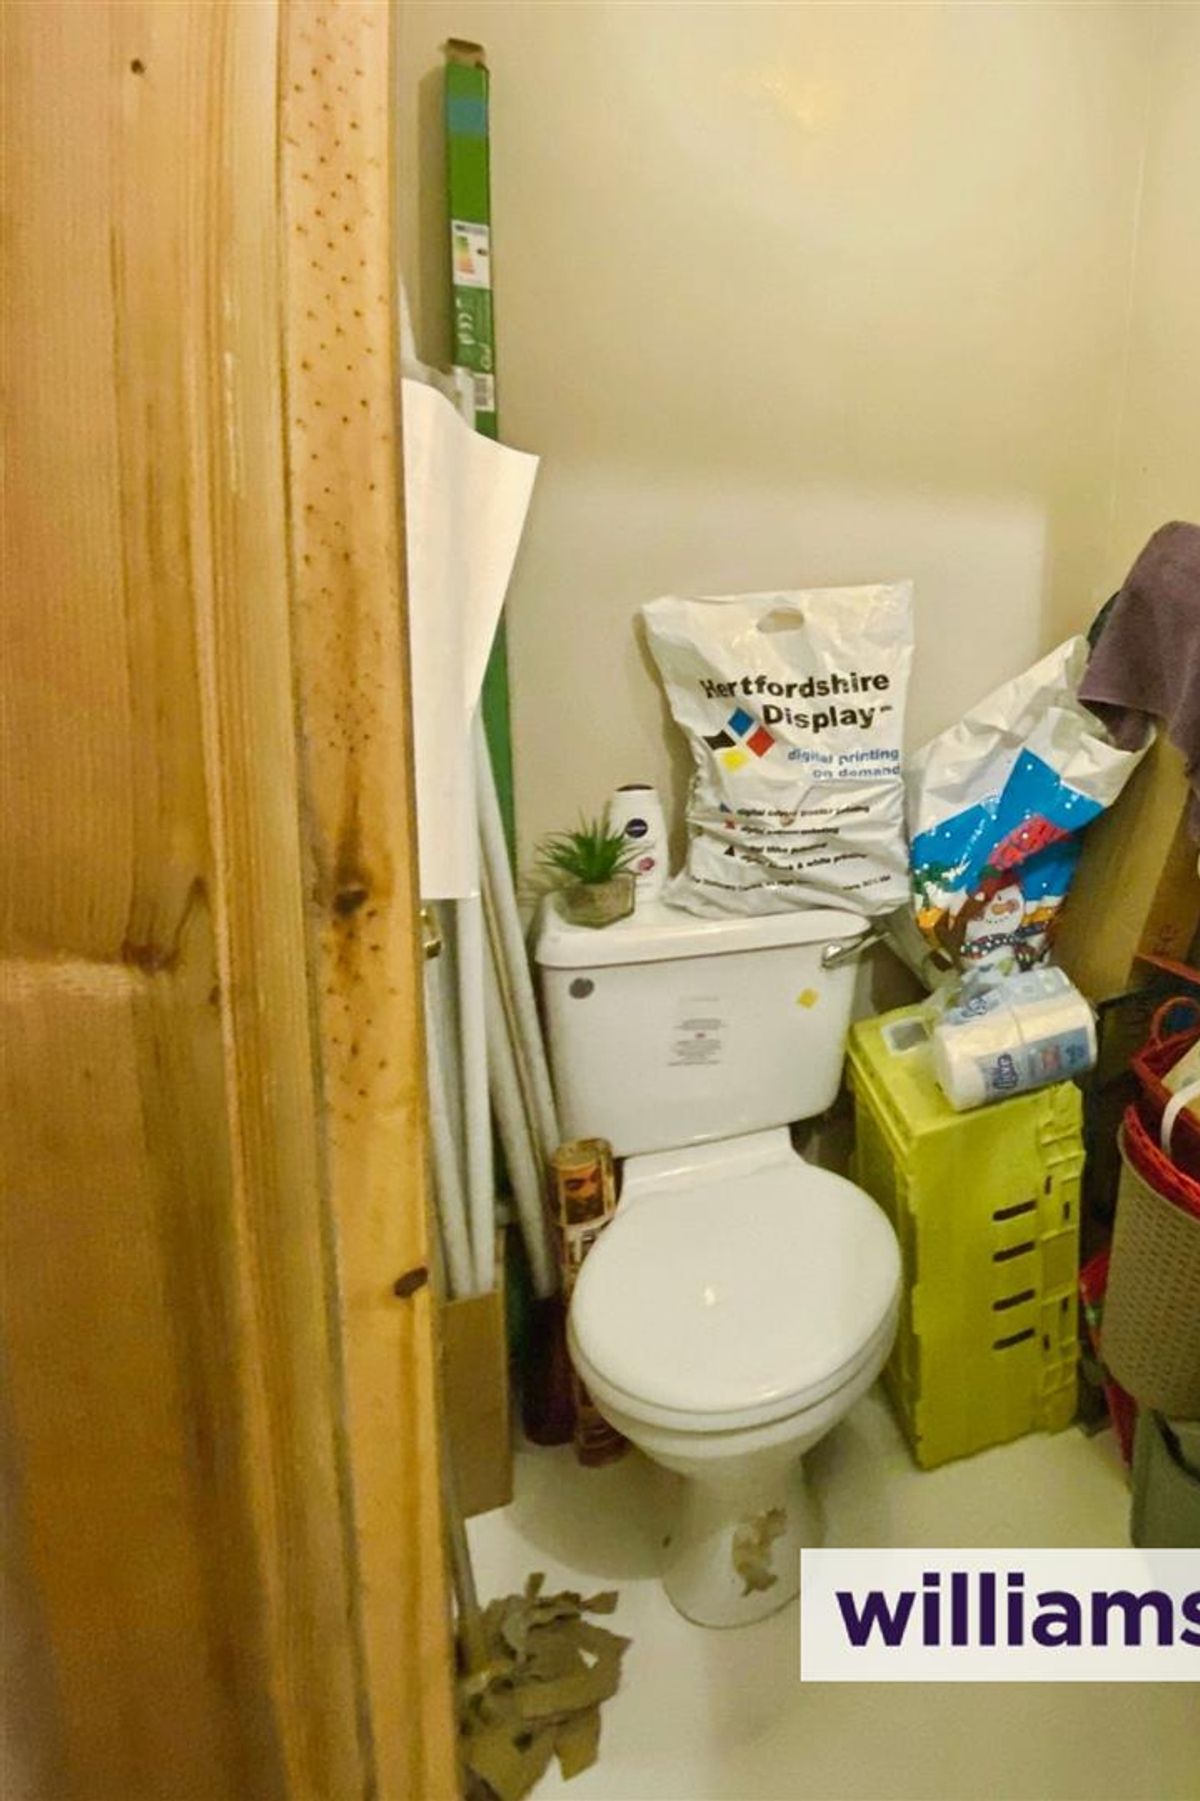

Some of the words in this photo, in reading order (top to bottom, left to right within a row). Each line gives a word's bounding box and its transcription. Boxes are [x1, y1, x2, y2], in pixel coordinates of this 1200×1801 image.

[700, 672, 890, 699] Hertfordshire
[762, 704, 876, 734] Display
[787, 747, 833, 764] digital
[838, 748, 900, 766] printing
[812, 768, 834, 779] on
[838, 762, 901, 778] demand
